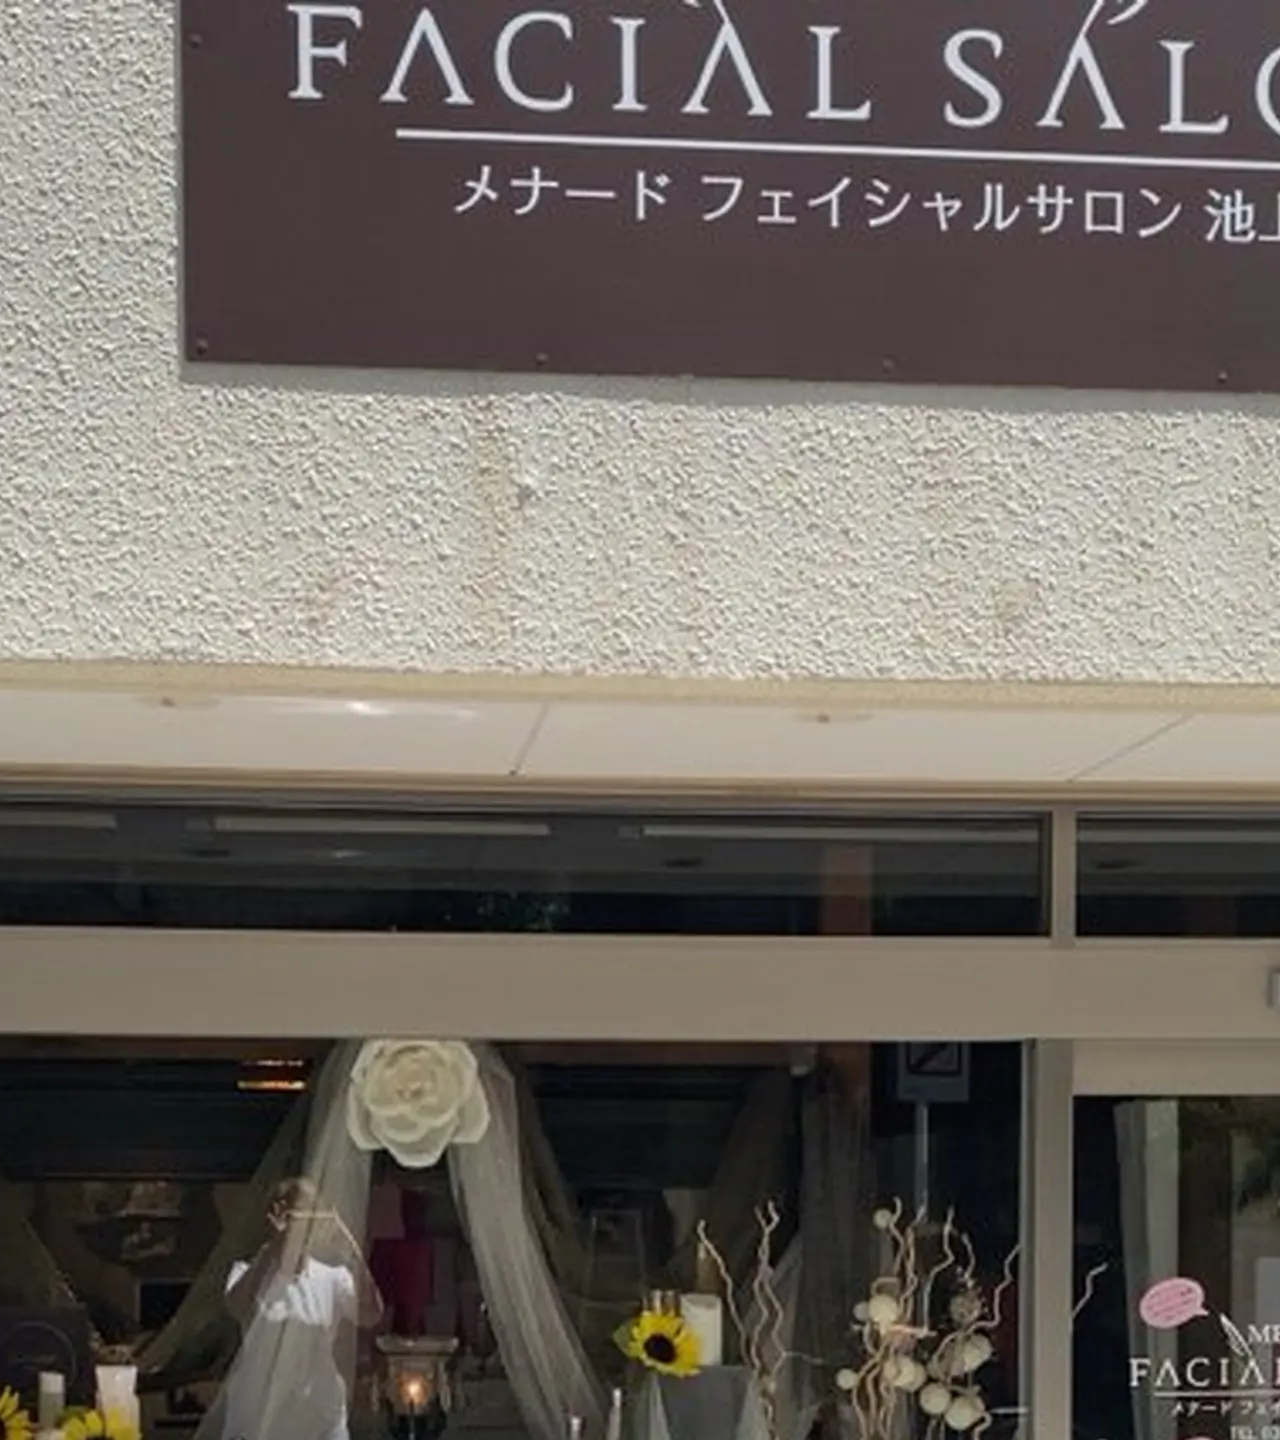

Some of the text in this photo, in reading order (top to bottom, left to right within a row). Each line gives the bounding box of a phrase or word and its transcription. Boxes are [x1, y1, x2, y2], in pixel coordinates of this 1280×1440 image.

[286, 3, 872, 121] FACIAL
[452, 165, 672, 218] メナード
[700, 175, 1183, 240] フェイシャルサロン
